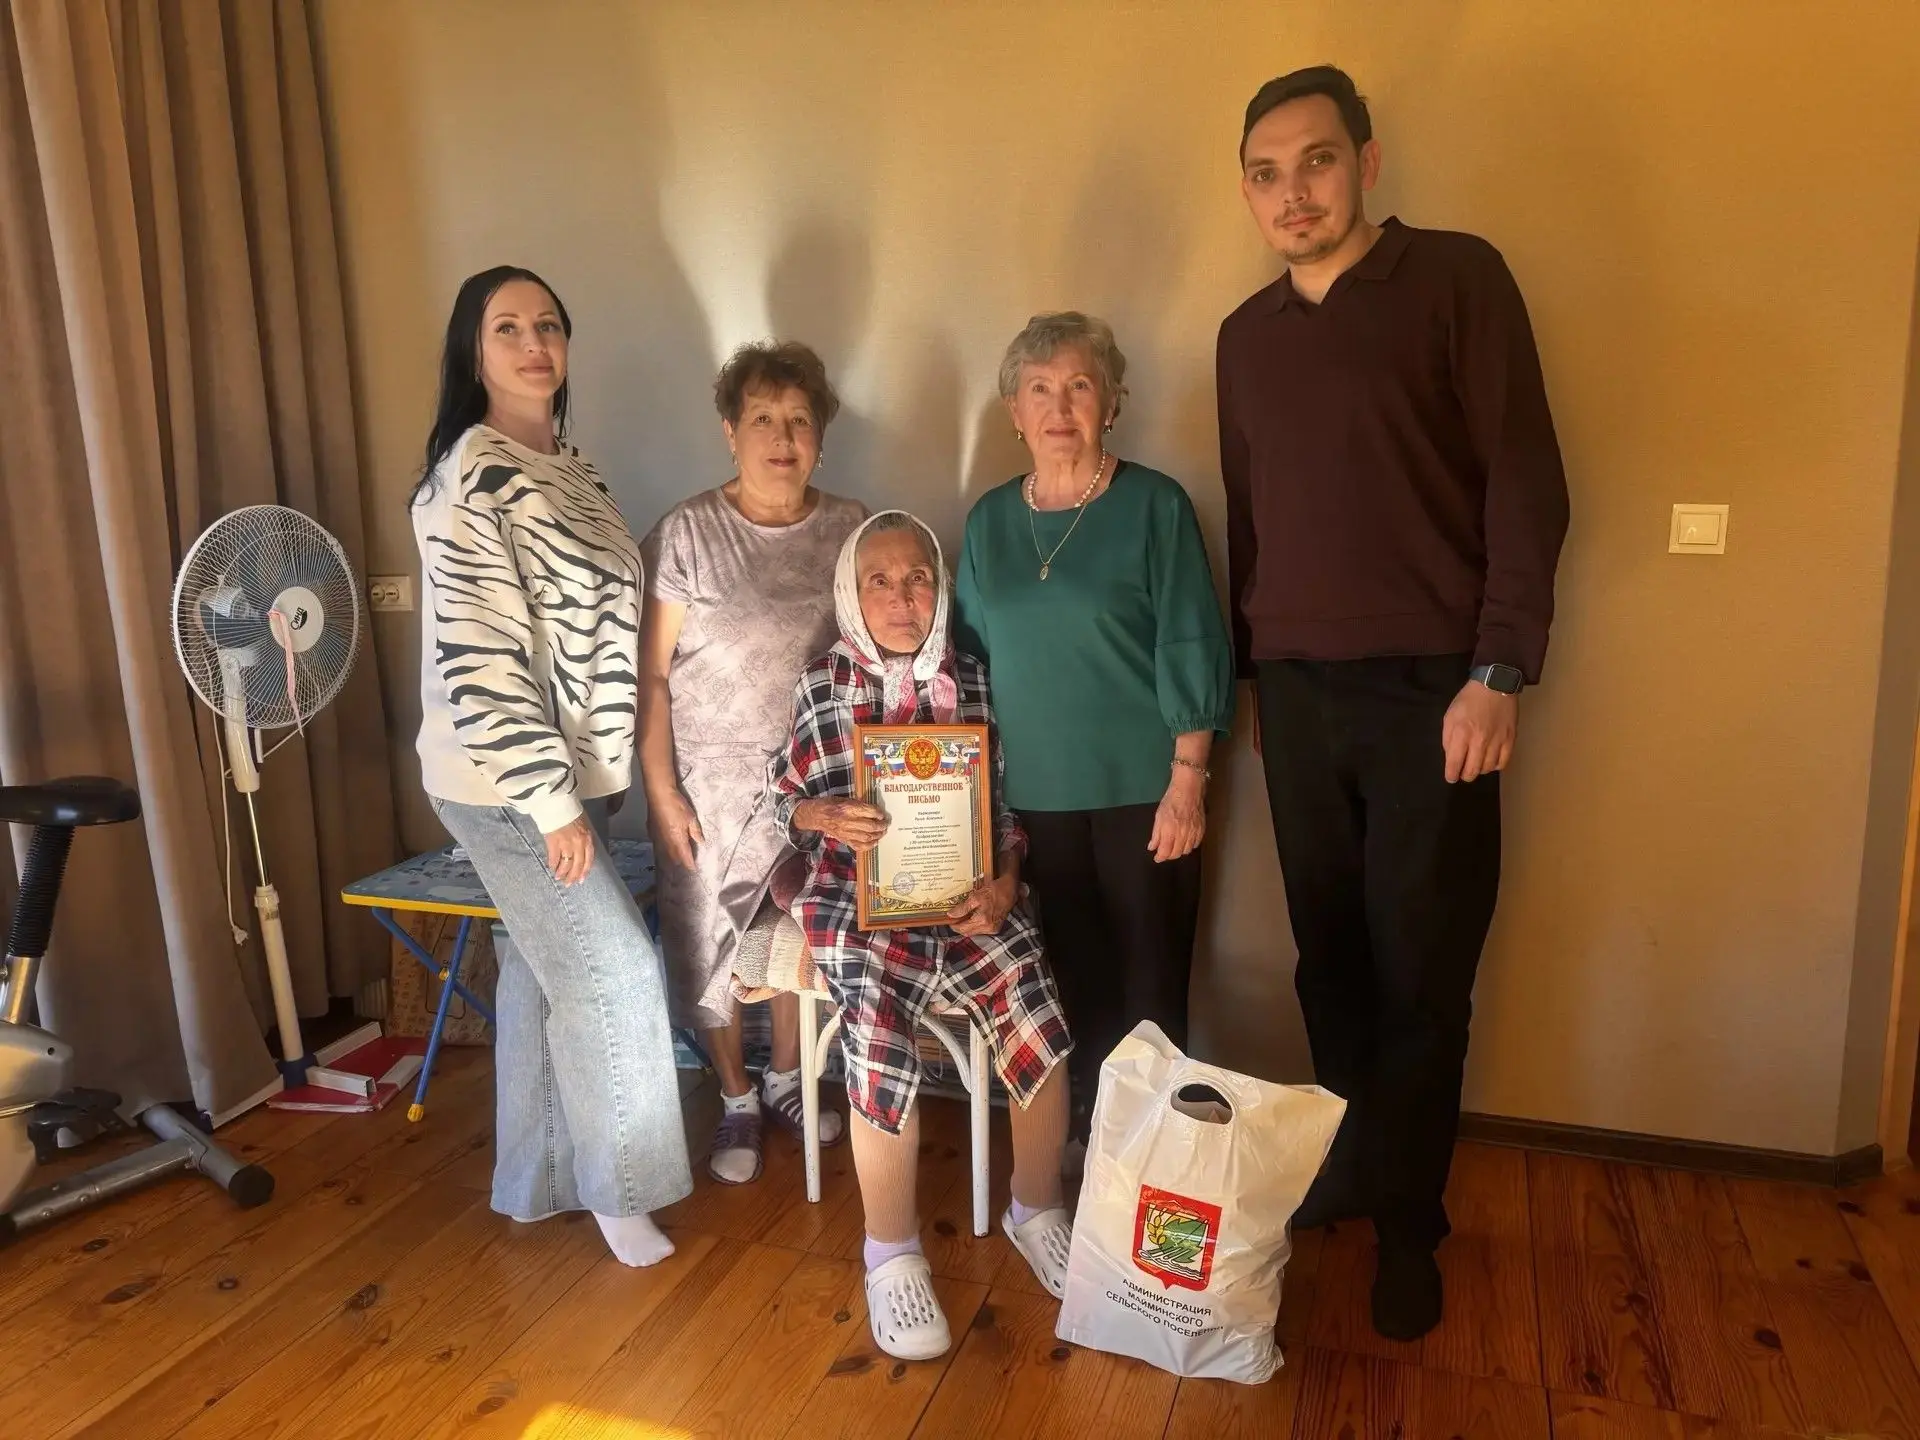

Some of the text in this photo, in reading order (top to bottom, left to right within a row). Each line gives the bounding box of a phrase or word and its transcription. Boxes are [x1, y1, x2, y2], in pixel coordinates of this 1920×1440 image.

[884, 782, 964, 793] БЛАГОДАРСТВЕННОЕ
[908, 795, 941, 804] ПИСЬМО
[1105, 1290, 1161, 1324] СЕЛЬСКОГО
[1122, 1279, 1212, 1316] АДМИНИСТРАЦИЯ
